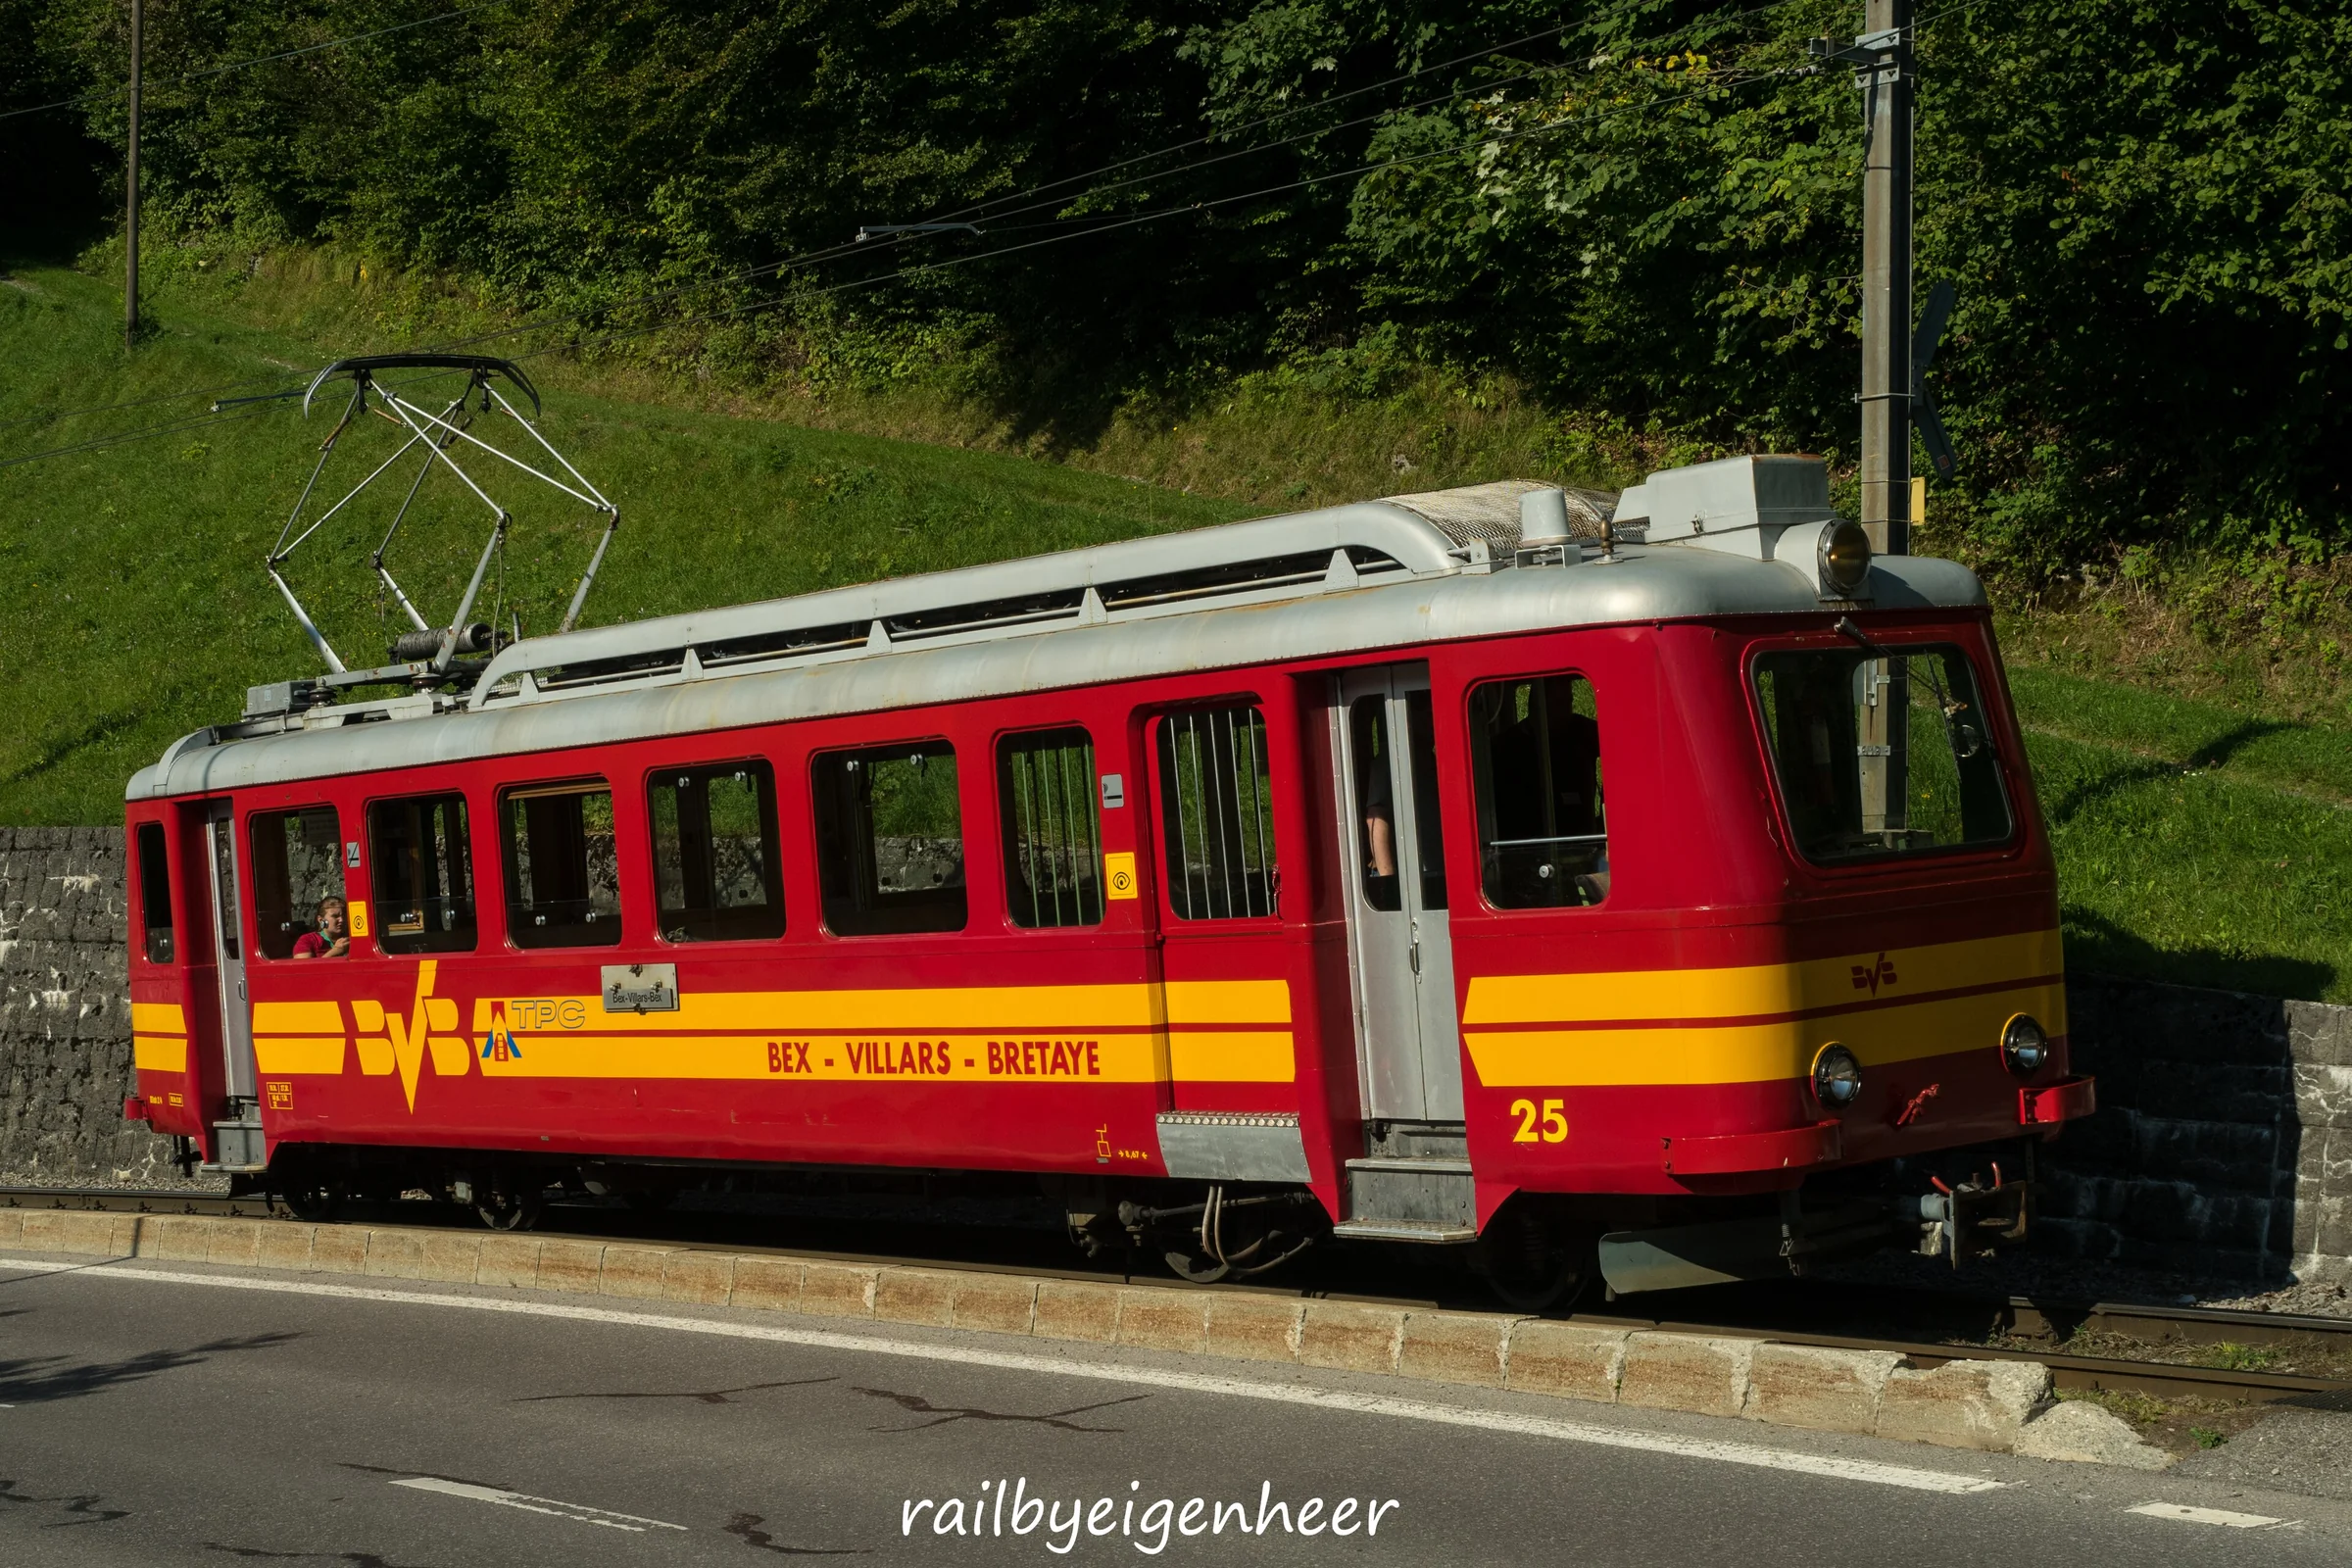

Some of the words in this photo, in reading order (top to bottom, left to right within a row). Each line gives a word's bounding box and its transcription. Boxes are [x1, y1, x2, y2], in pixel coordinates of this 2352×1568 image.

[1850, 952, 1897, 997] BVB
[512, 1000, 585, 1029] TPC
[612, 991, 662, 1004] Bex-Villars-Bex
[351, 959, 470, 1115] BVB
[767, 1042, 812, 1073] BEX
[846, 1041, 952, 1075] VILLARS
[987, 1041, 1101, 1076] BRETAYE
[1510, 1099, 1568, 1144] 25
